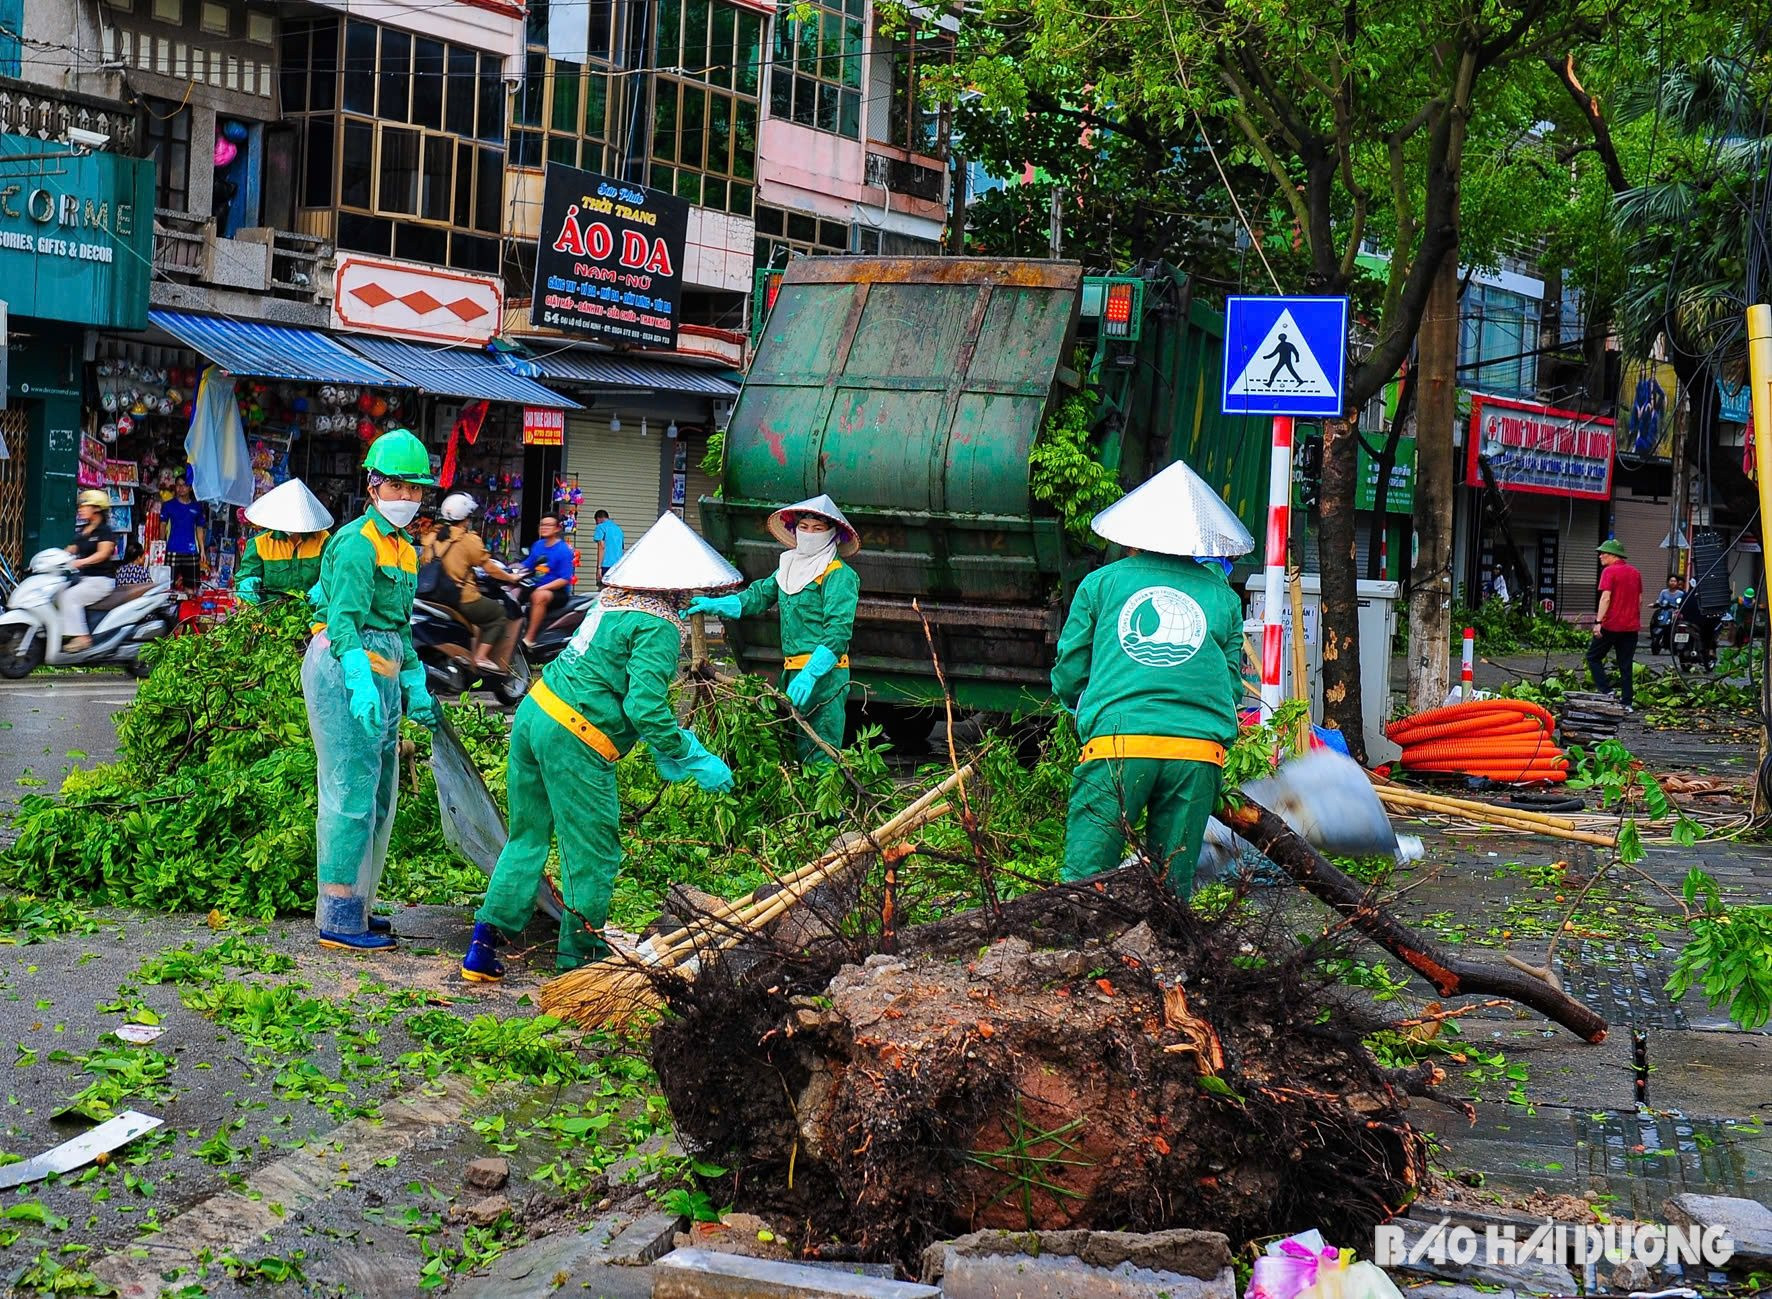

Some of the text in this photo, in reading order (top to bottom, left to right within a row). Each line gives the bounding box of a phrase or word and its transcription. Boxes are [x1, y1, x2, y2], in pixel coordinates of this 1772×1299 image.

[615, 204, 657, 226] TRANG
[37, 236, 67, 256] GIFTS
[68, 242, 78, 258] &
[79, 243, 113, 263] DECOR
[619, 229, 673, 277] DA
[544, 311, 560, 324] 54
